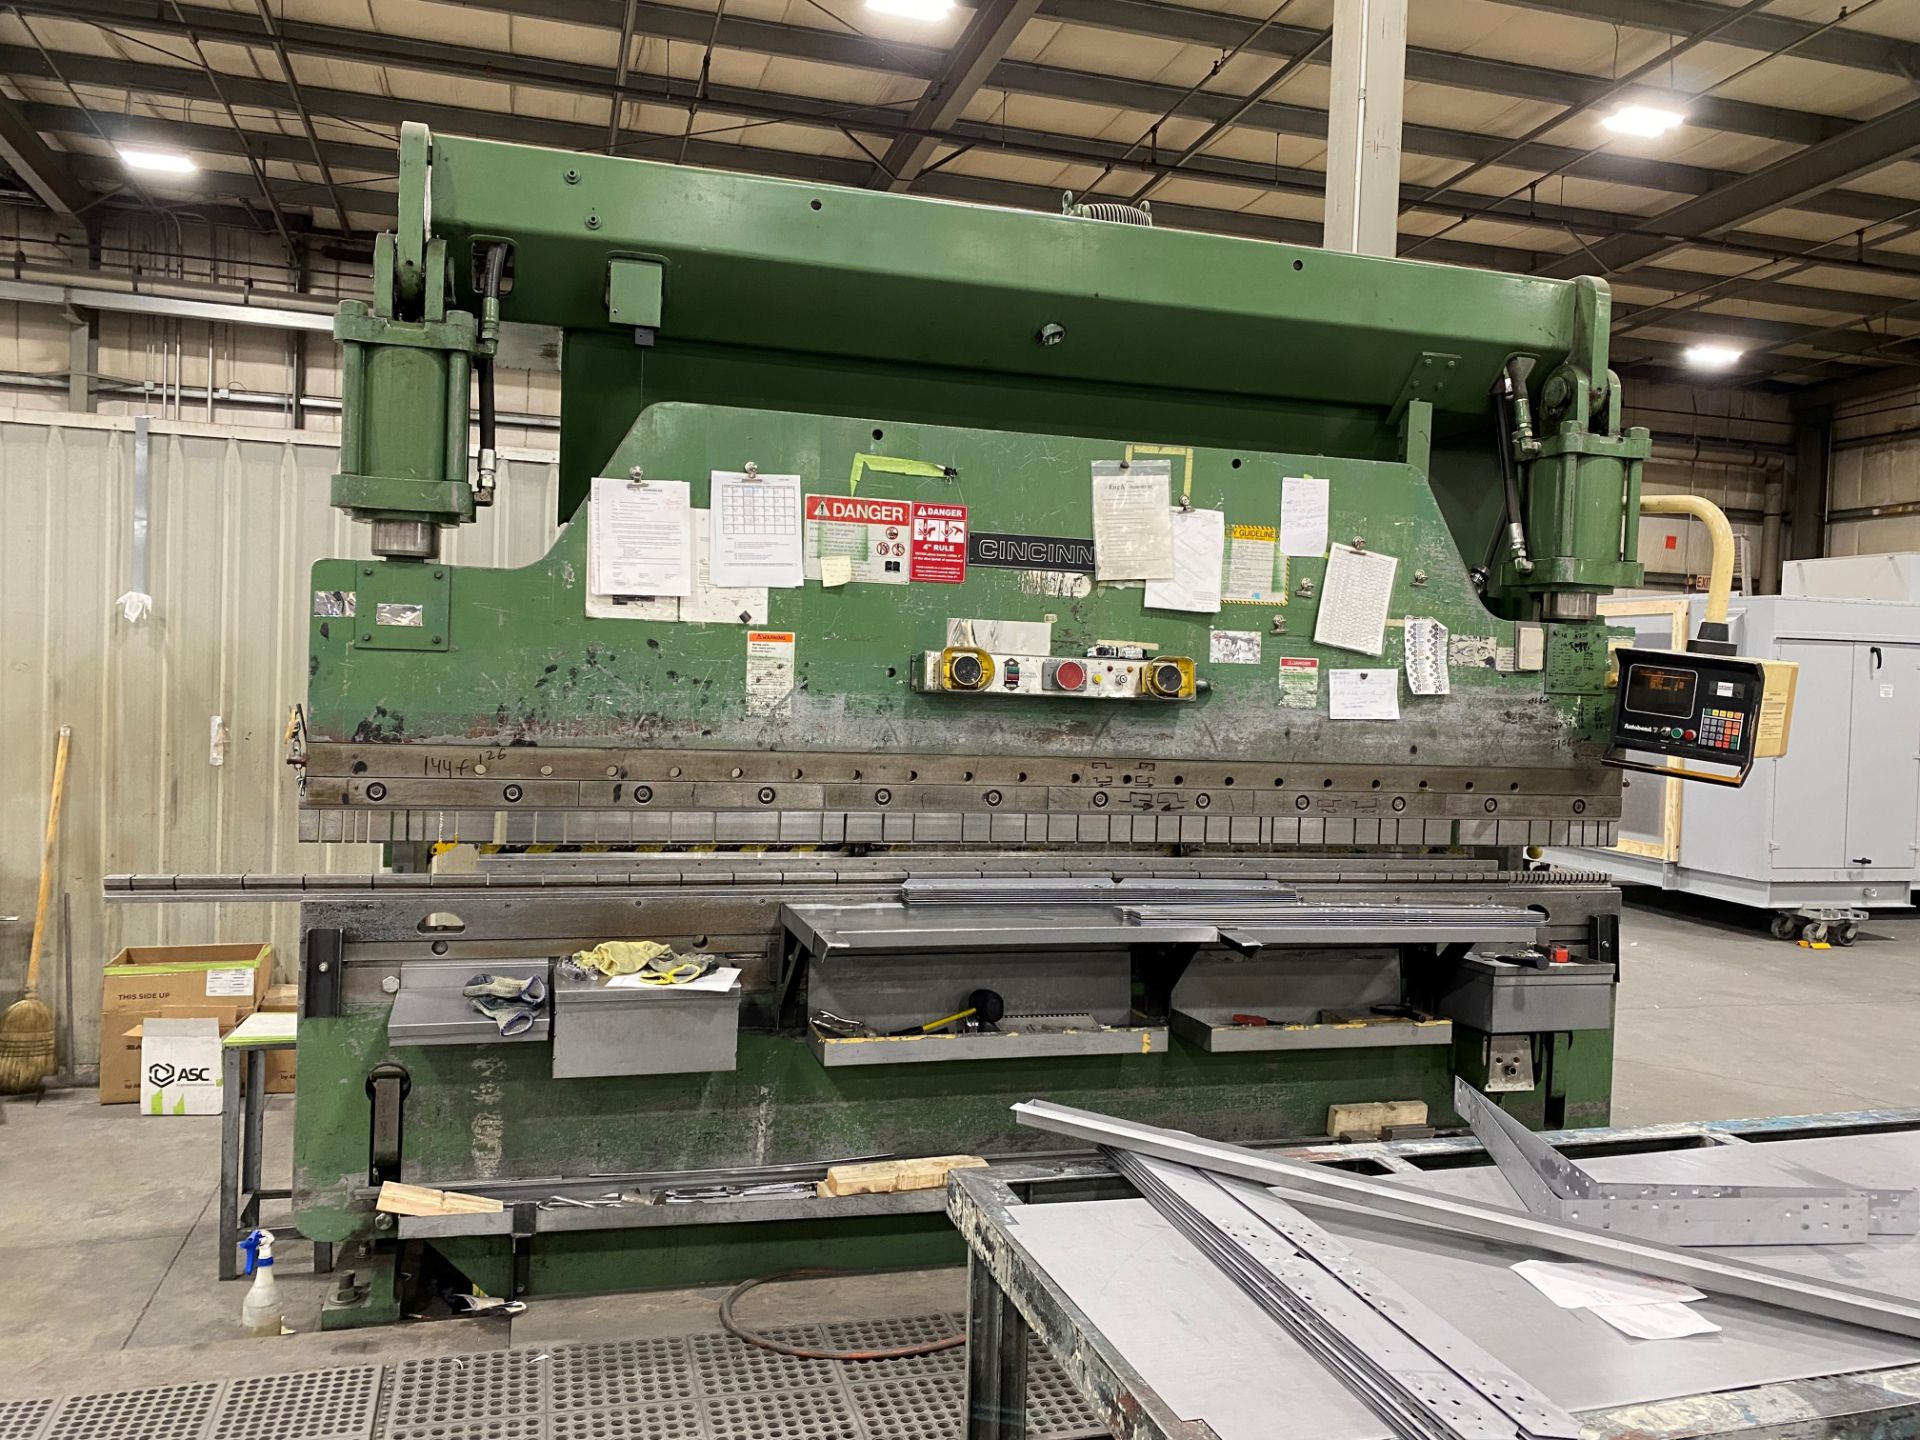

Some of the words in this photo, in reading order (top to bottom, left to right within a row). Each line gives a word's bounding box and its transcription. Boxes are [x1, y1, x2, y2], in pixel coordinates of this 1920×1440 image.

[832, 502, 904, 522] DANGER
[927, 507, 963, 518] DANGER
[933, 544, 955, 552] RULE
[118, 993, 138, 1001] THIS
[177, 1067, 210, 1082] ASC
